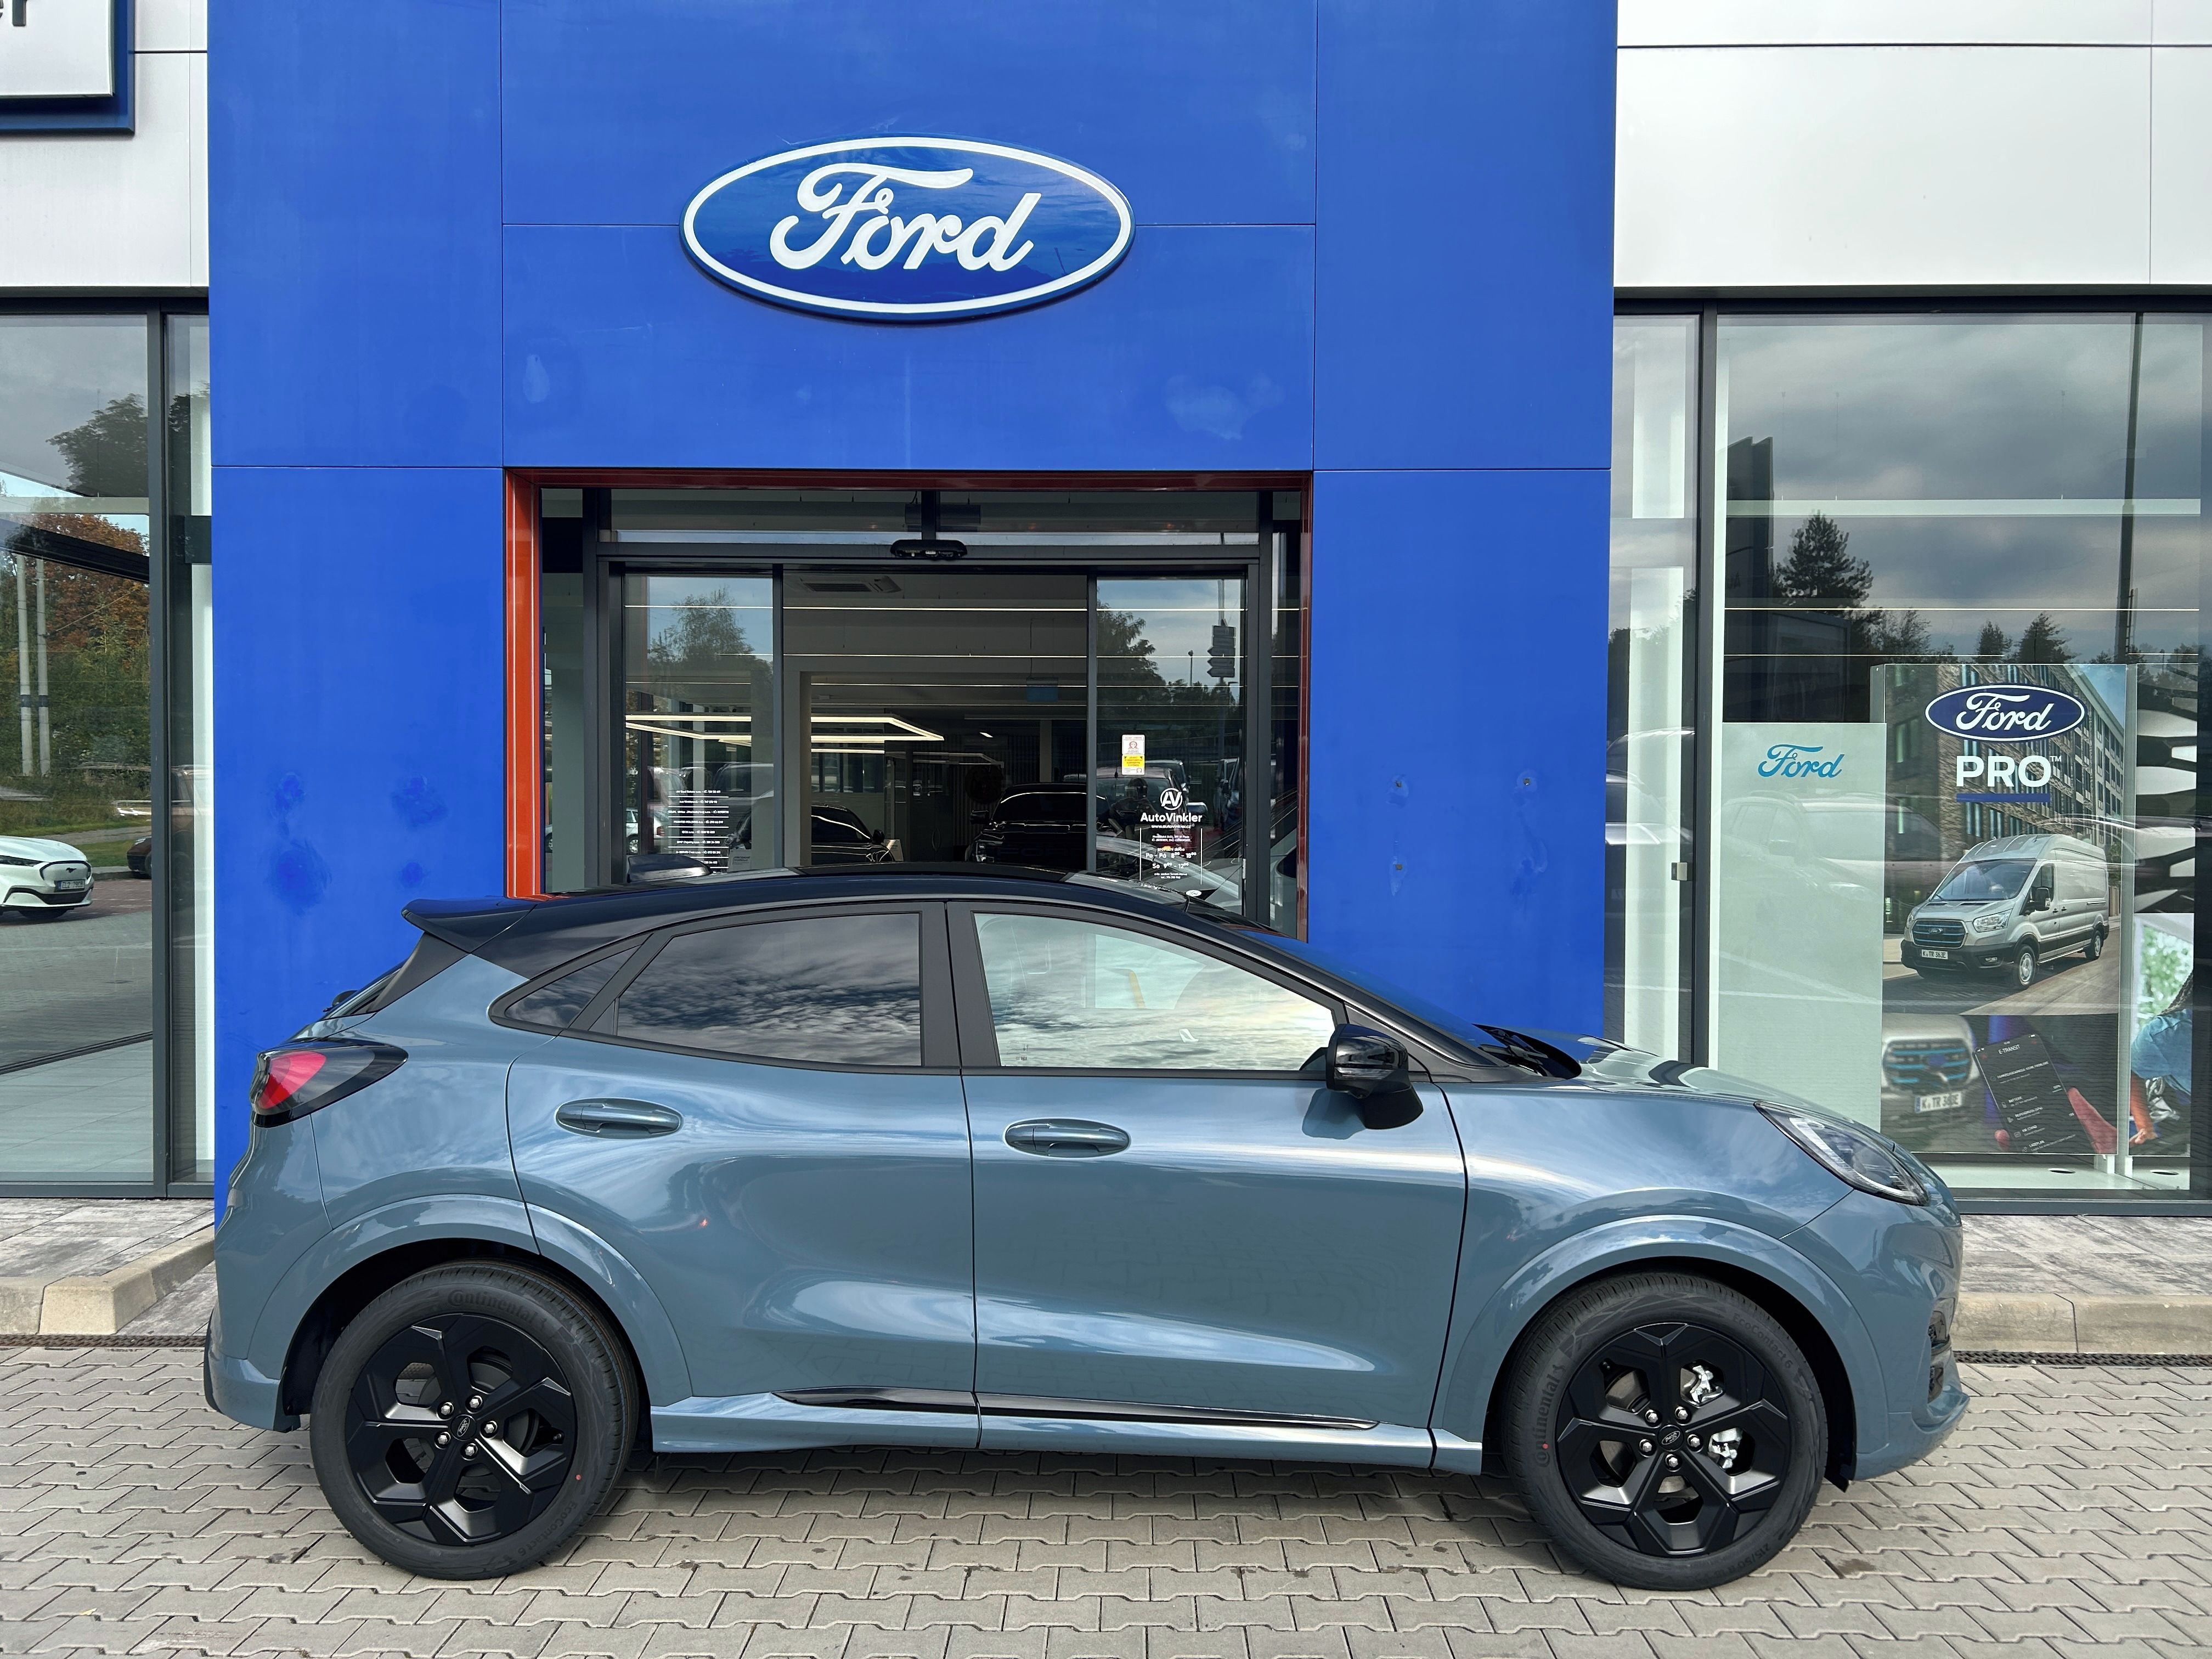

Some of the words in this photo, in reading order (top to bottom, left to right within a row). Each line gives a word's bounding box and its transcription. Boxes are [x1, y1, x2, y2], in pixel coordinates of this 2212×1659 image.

[770, 163, 1042, 272] Ford
[1956, 692, 2055, 731] Ford
[1758, 744, 1845, 778] Ford
[1956, 755, 2052, 787] PRO
[1140, 812, 1203, 822] AutoVinkler
[1998, 1044, 2021, 1054] E-TRANSIT
[448, 1289, 538, 1324] Continental
[1733, 1313, 1786, 1361] EcoContact
[1785, 1360, 1793, 1368] 6
[1532, 1374, 1561, 1468] Continental
[526, 1500, 578, 1550] EcoContact
